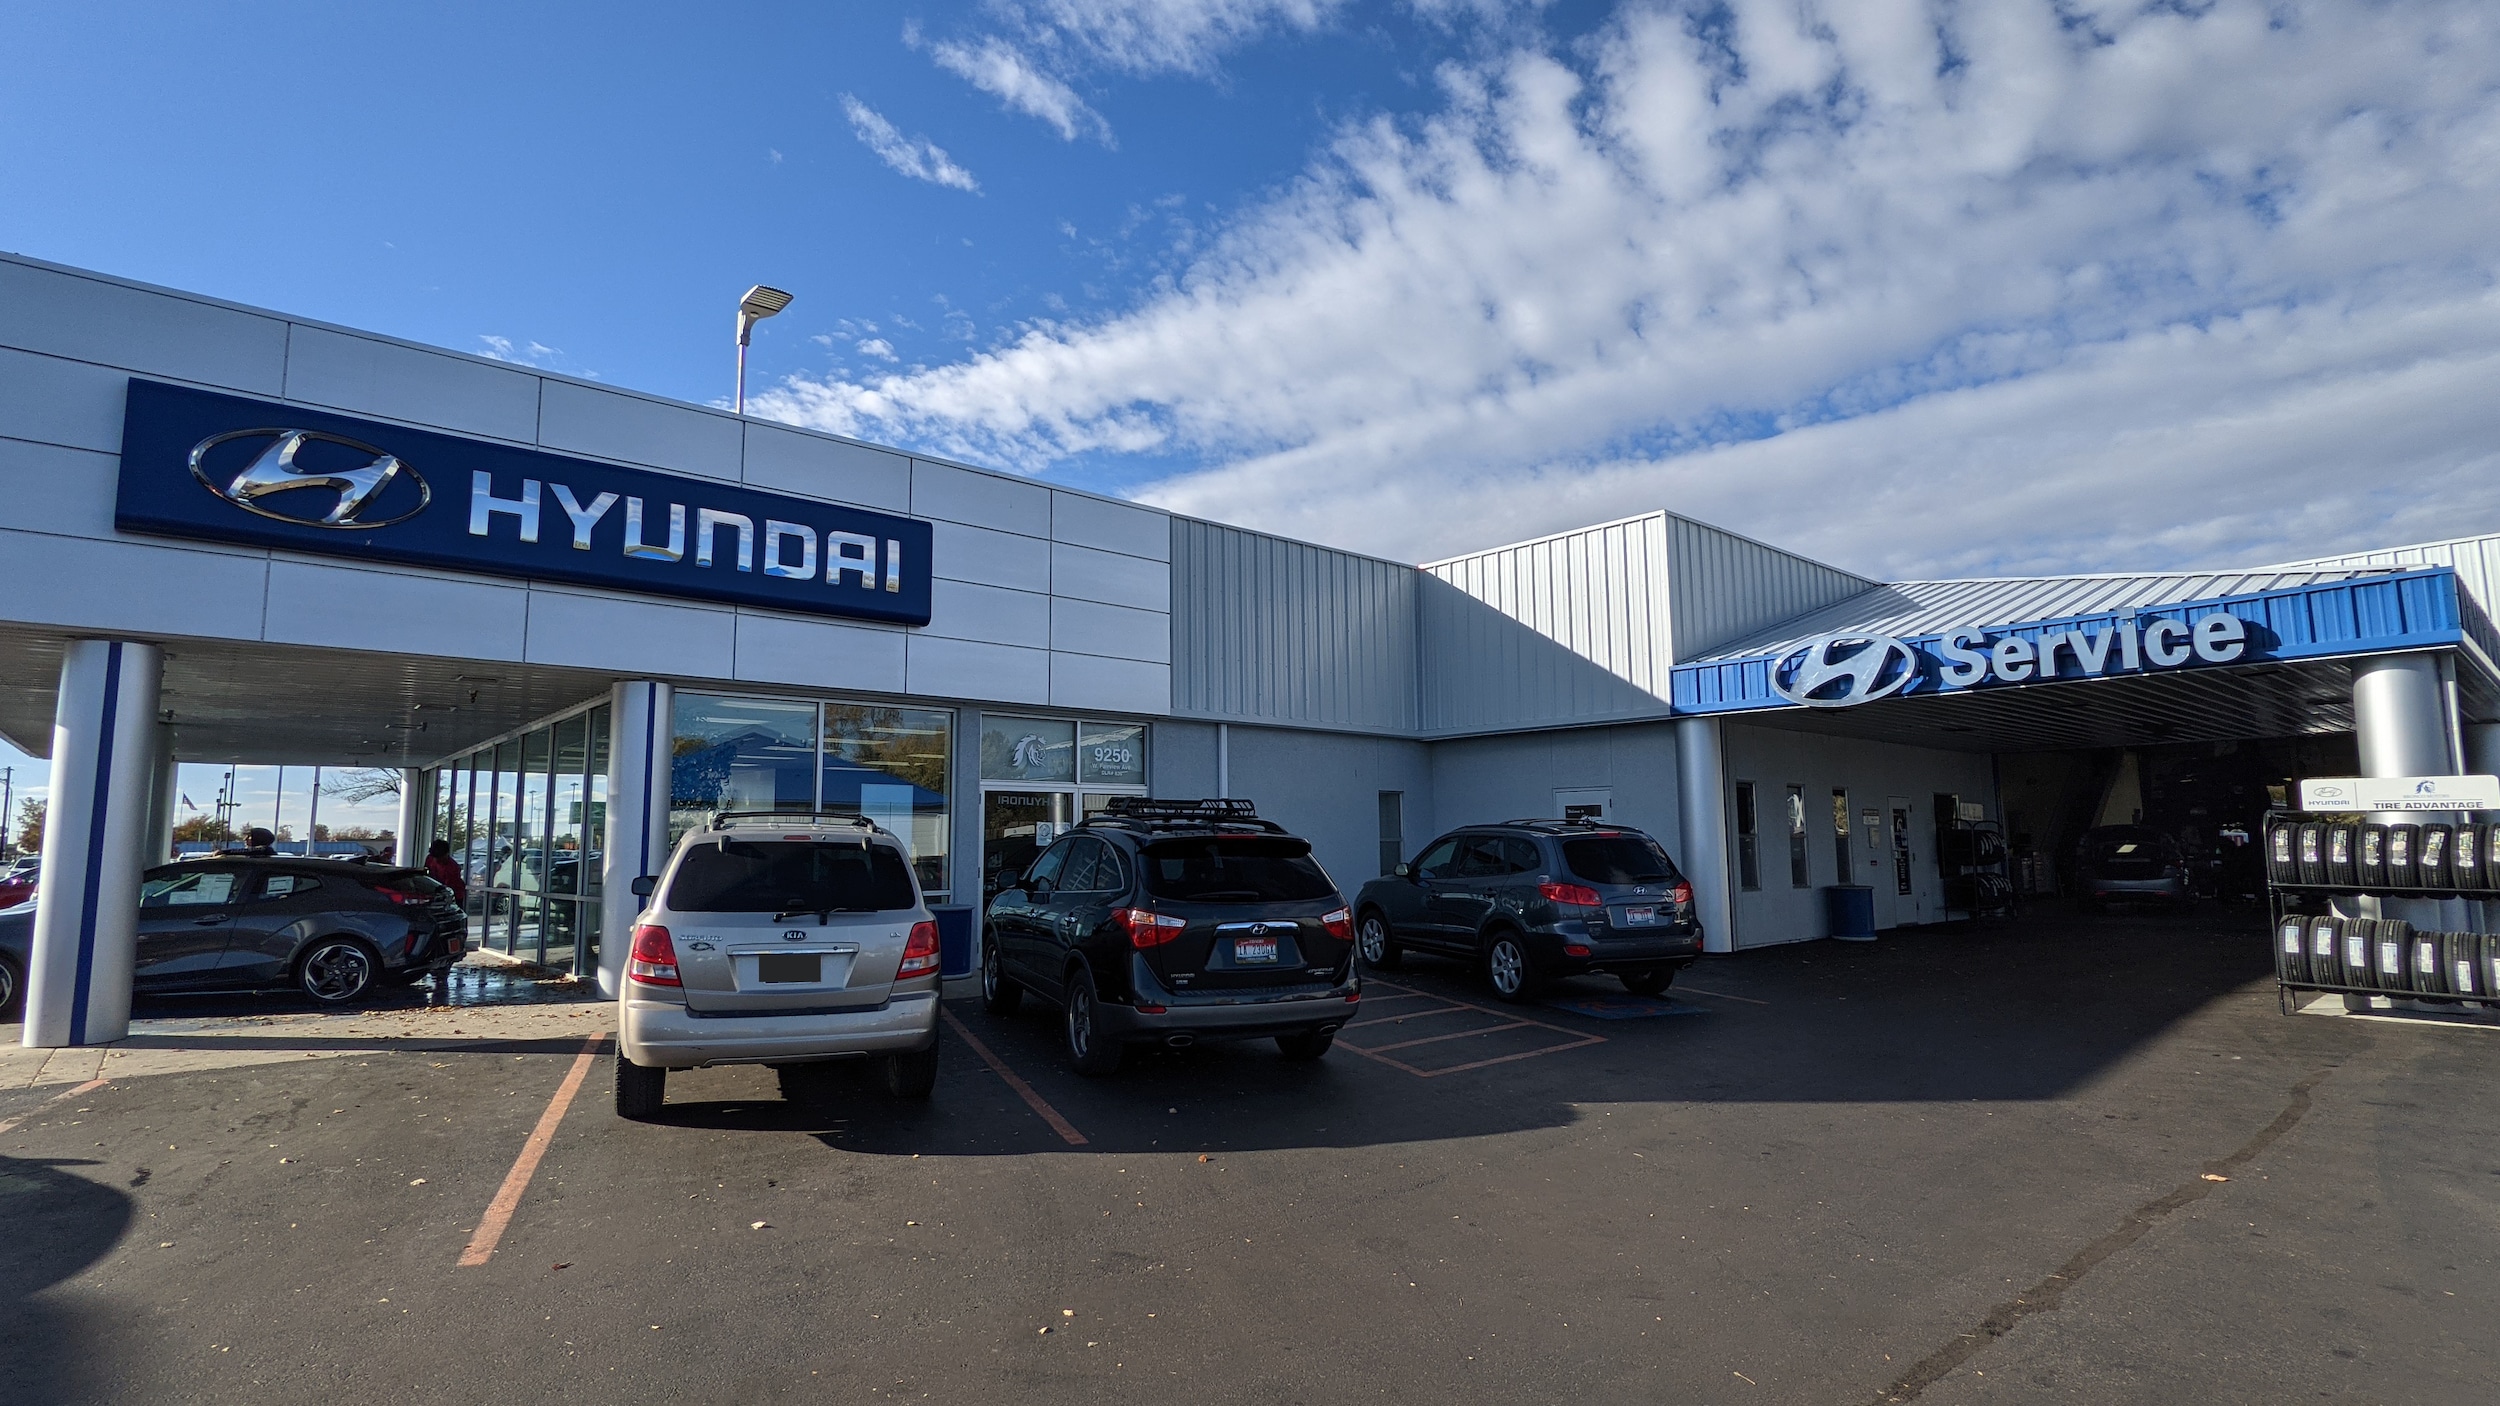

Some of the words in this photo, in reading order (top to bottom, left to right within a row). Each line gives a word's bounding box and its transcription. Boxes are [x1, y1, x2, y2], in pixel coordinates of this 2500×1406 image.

[468, 470, 901, 593] HYUNDAI
[1939, 606, 2246, 688] Service
[1094, 747, 1130, 763] 9250
[2404, 801, 2484, 809] ADVANTAGE
[786, 931, 804, 939] KIA
